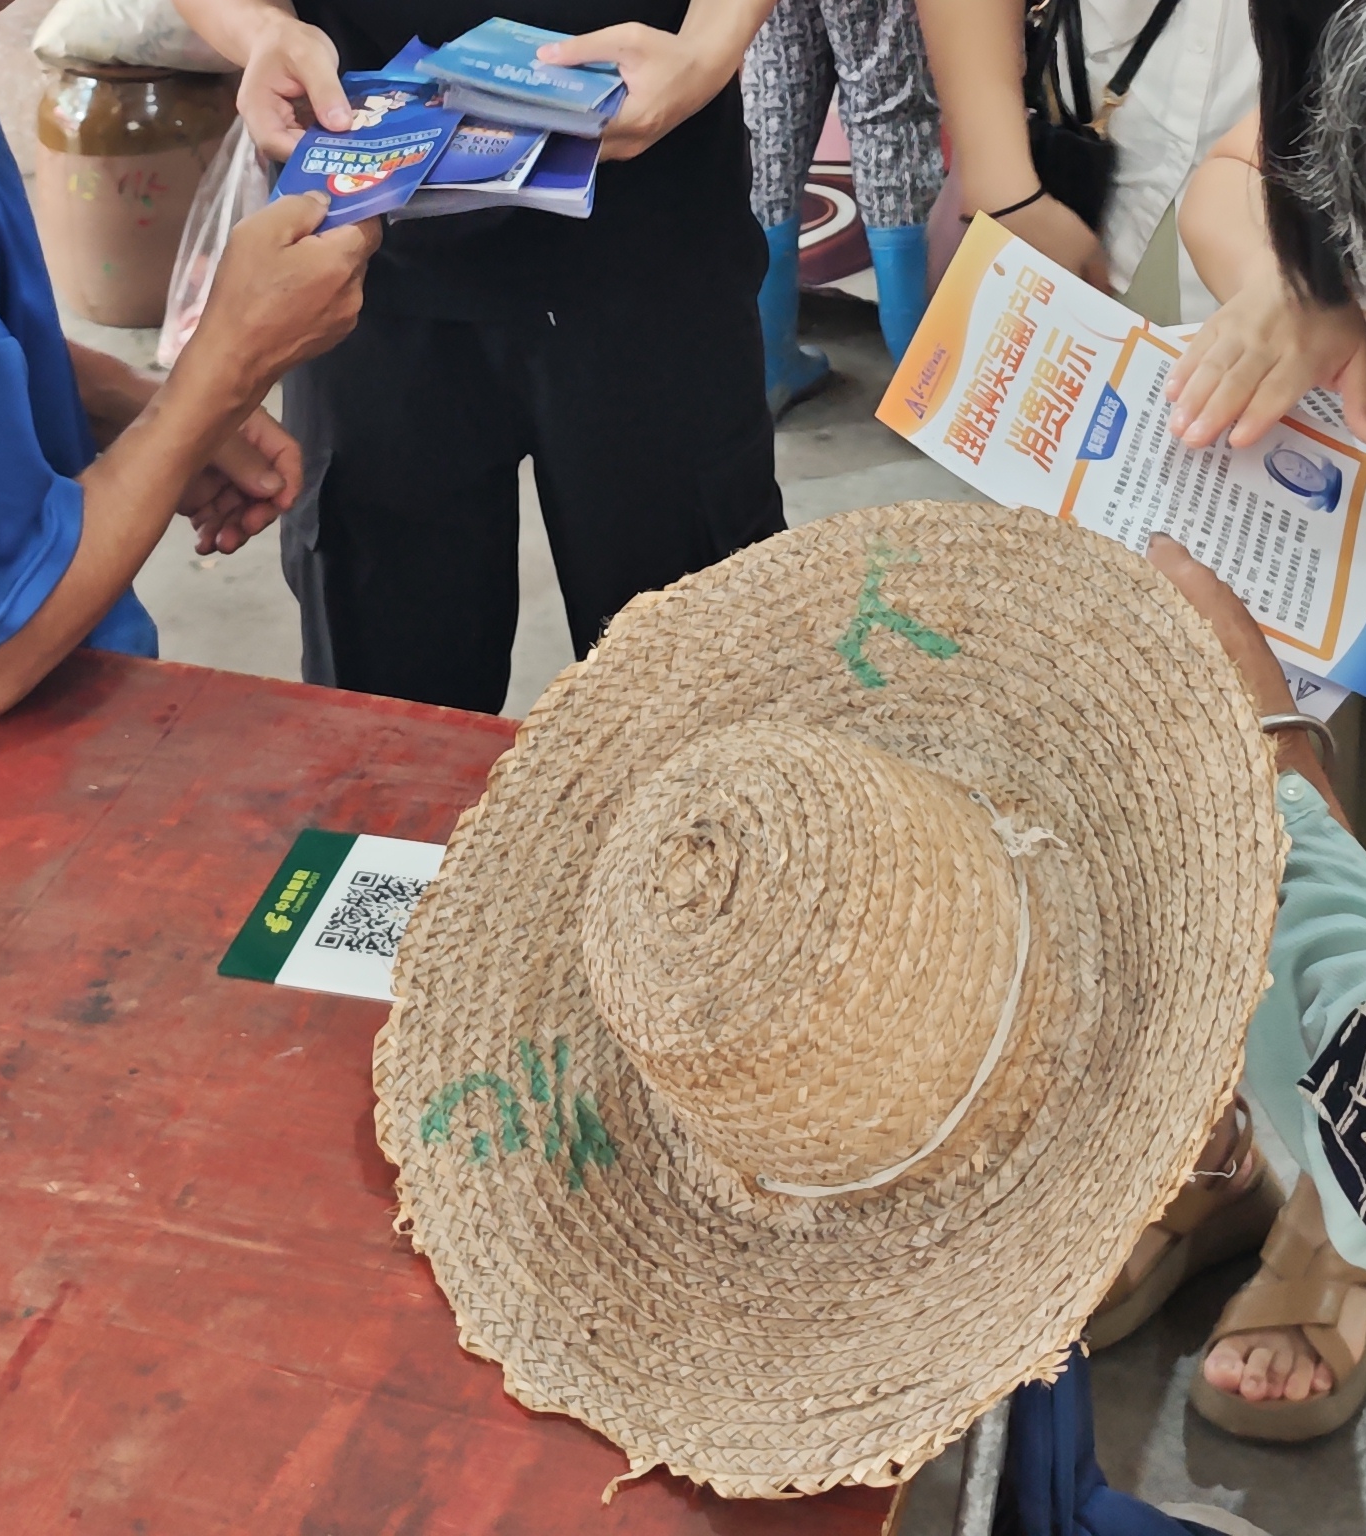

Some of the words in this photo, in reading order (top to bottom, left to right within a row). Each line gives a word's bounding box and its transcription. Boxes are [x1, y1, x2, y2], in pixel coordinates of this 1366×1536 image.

[941, 264, 1056, 465] 理性购买金融产品
[1003, 326, 1098, 472] 消费提示
[274, 868, 311, 912] 中国邮政
